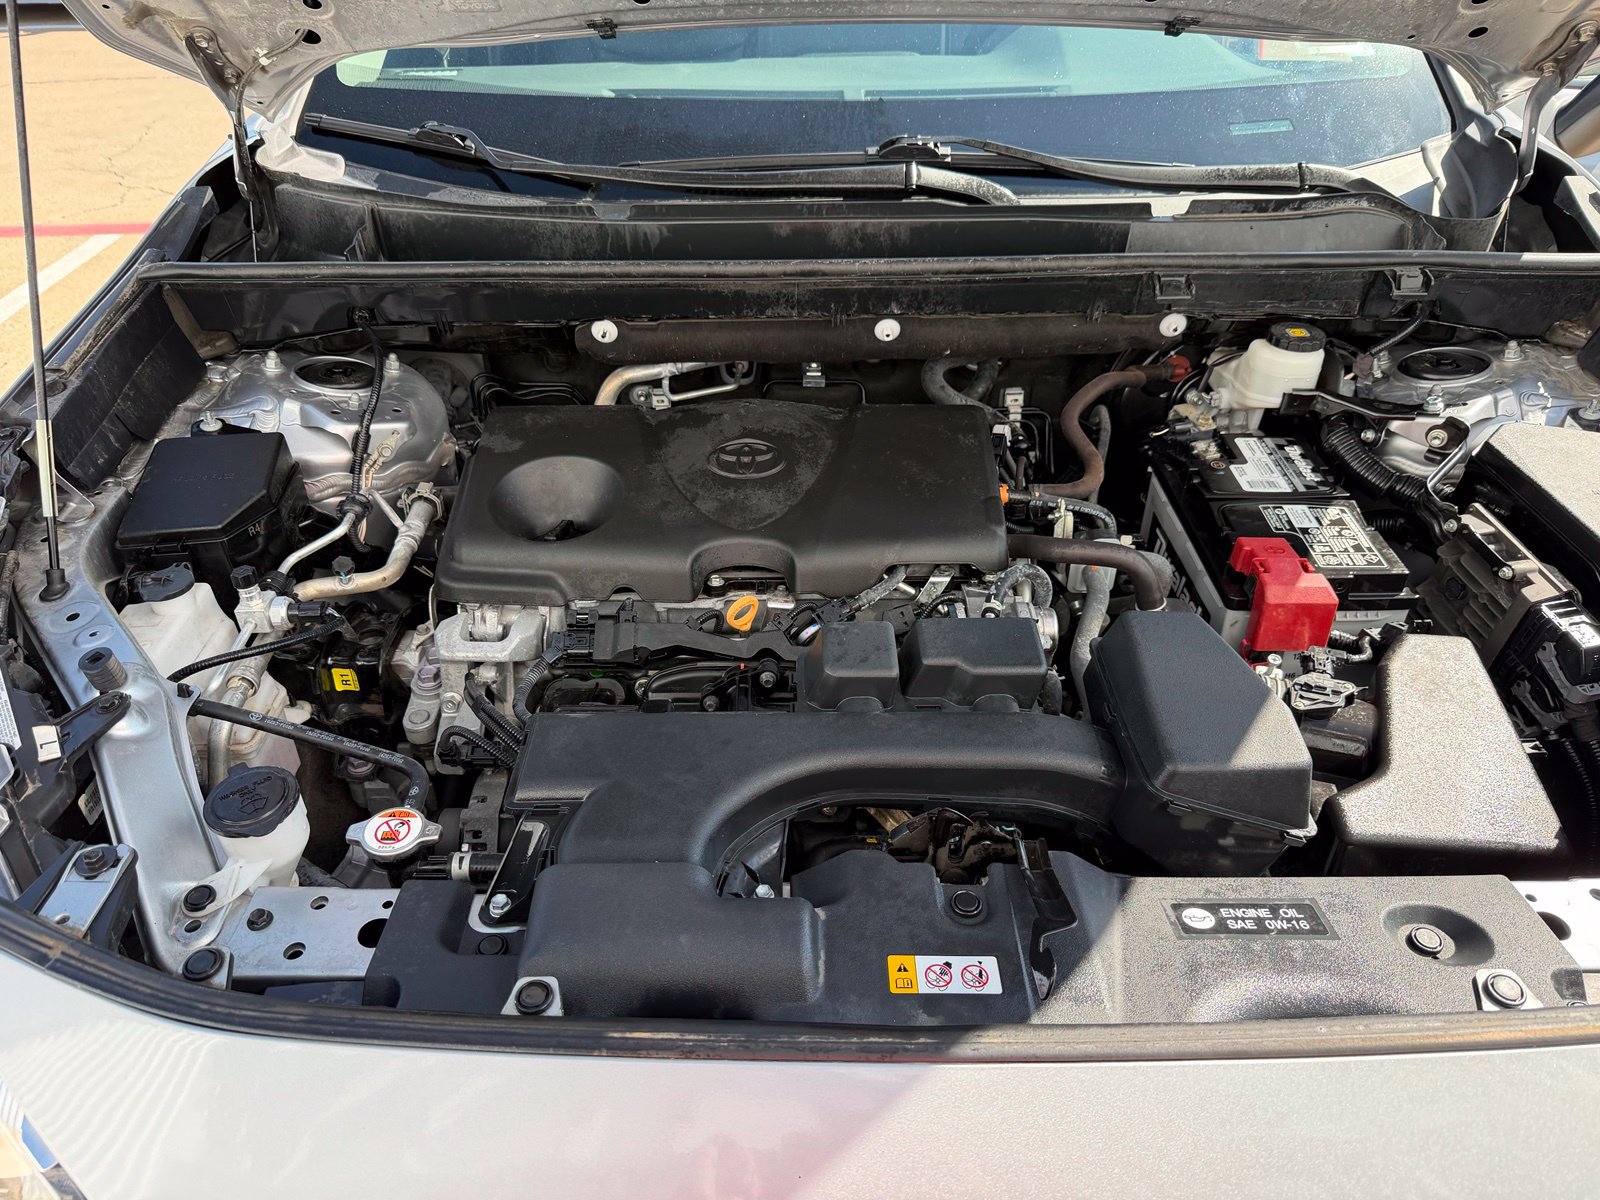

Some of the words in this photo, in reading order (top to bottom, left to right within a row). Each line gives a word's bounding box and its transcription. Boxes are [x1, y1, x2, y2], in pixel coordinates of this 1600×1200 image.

[1284, 445, 1325, 482] Duralast
[340, 674, 351, 686] R1
[1219, 908, 1272, 918] ENGINE
[1279, 908, 1305, 918] OIL
[1226, 919, 1258, 930] SAE
[1265, 919, 1310, 930] 0W-16
